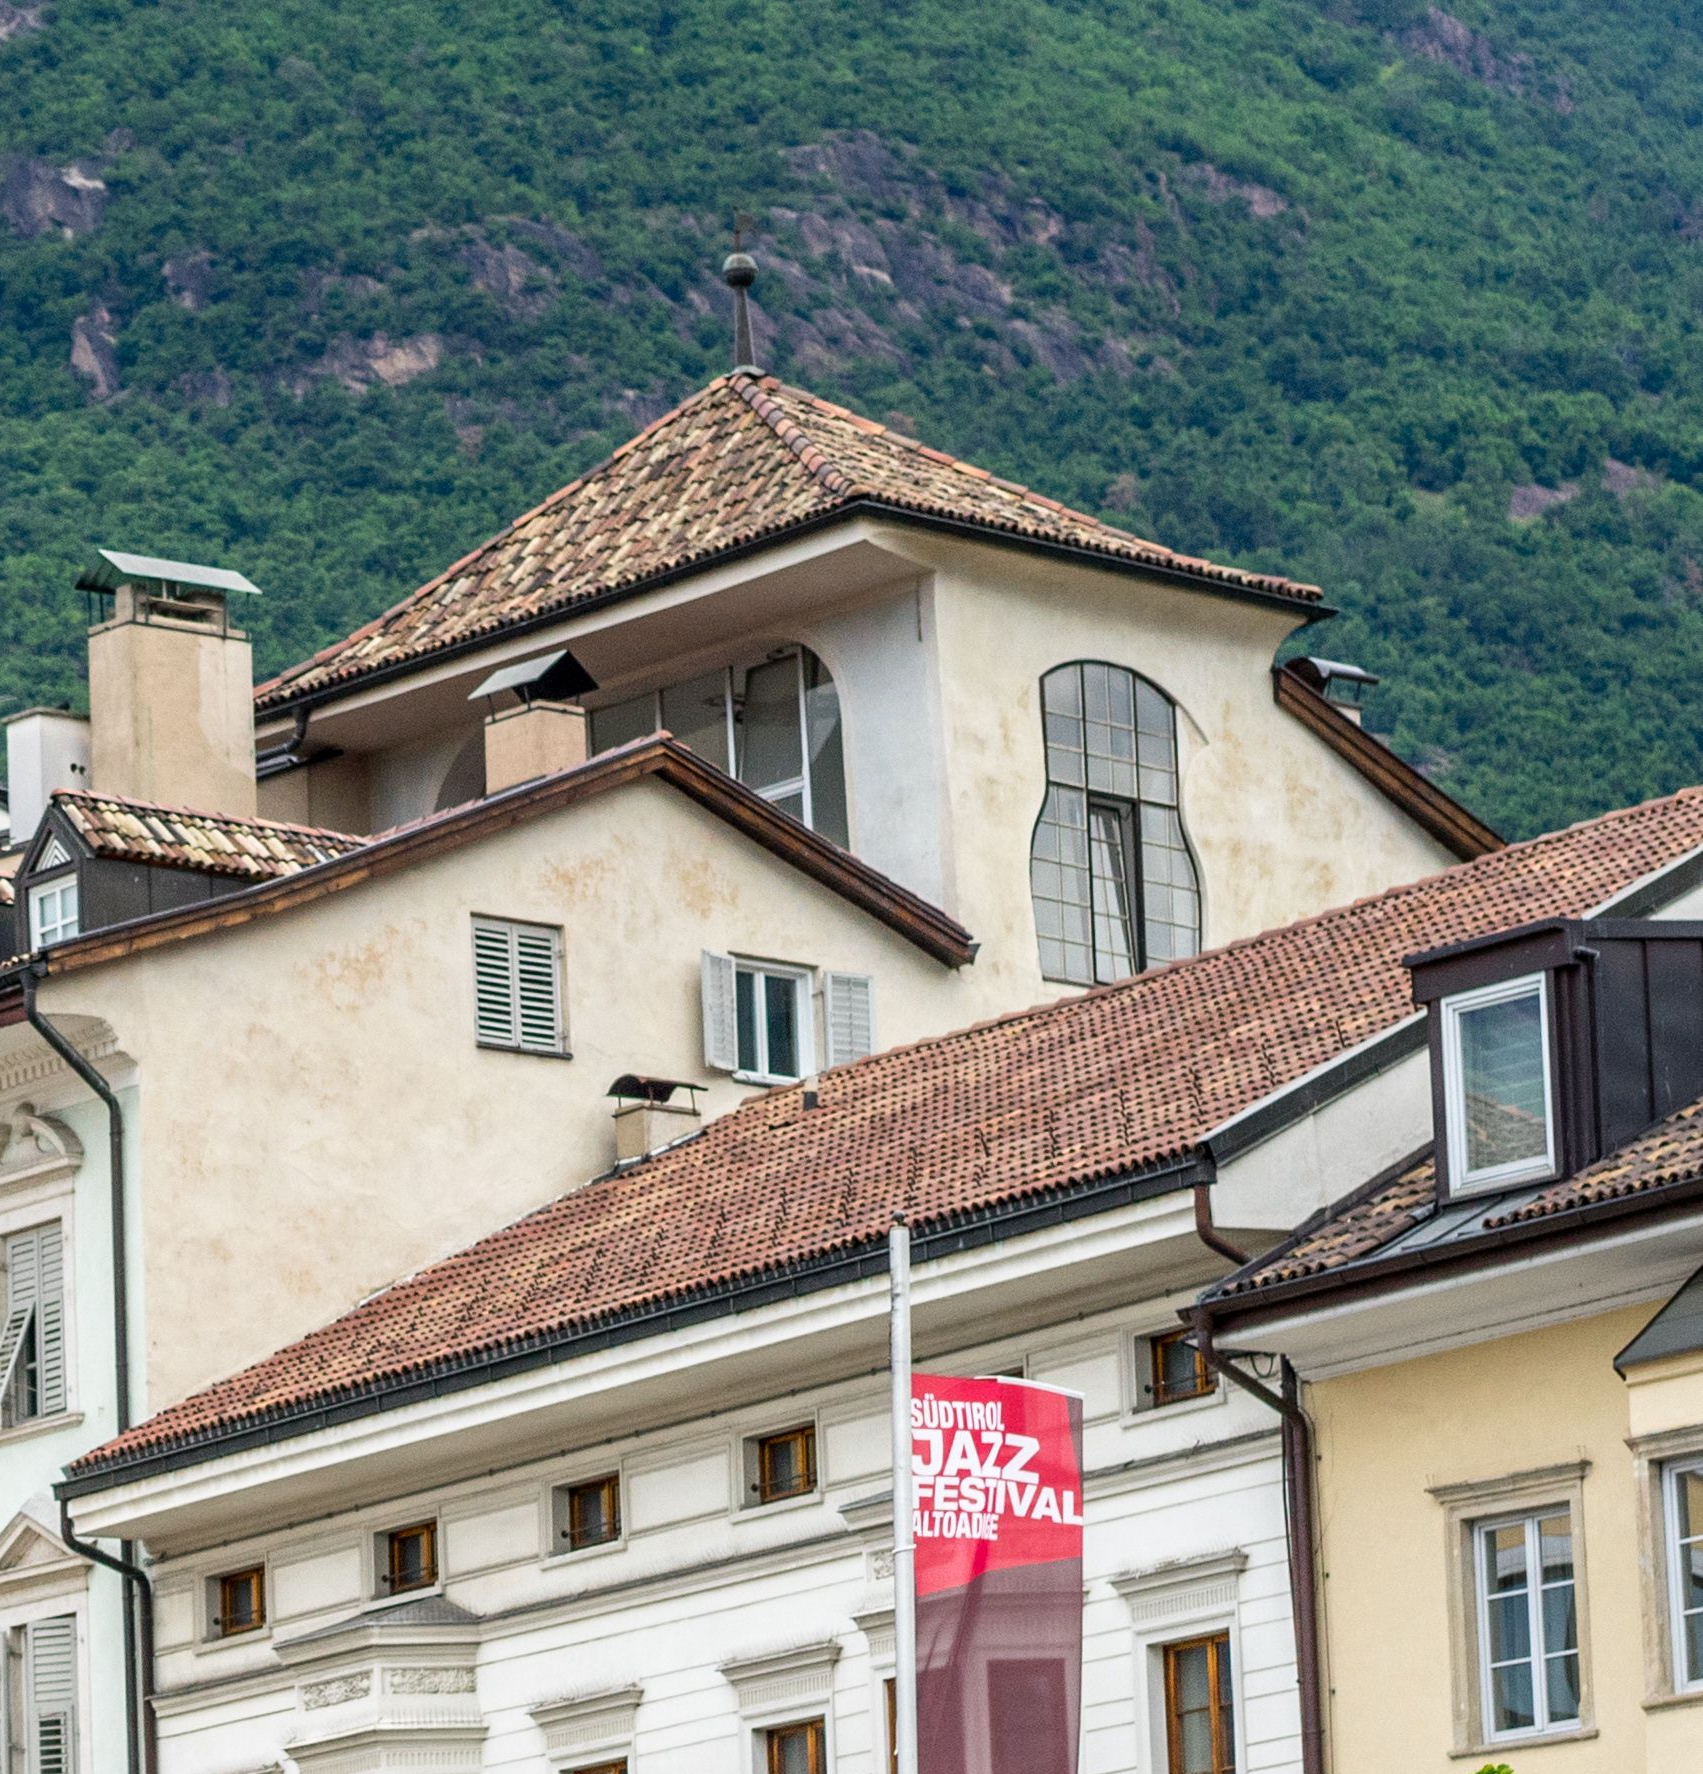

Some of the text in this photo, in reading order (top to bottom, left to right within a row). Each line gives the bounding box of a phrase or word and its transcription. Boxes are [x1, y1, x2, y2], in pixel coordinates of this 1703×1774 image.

[911, 1393, 1005, 1431] SÜDTIROL
[911, 1428, 1041, 1484] JAZZ
[912, 1476, 1083, 1526] FESTIVAL
